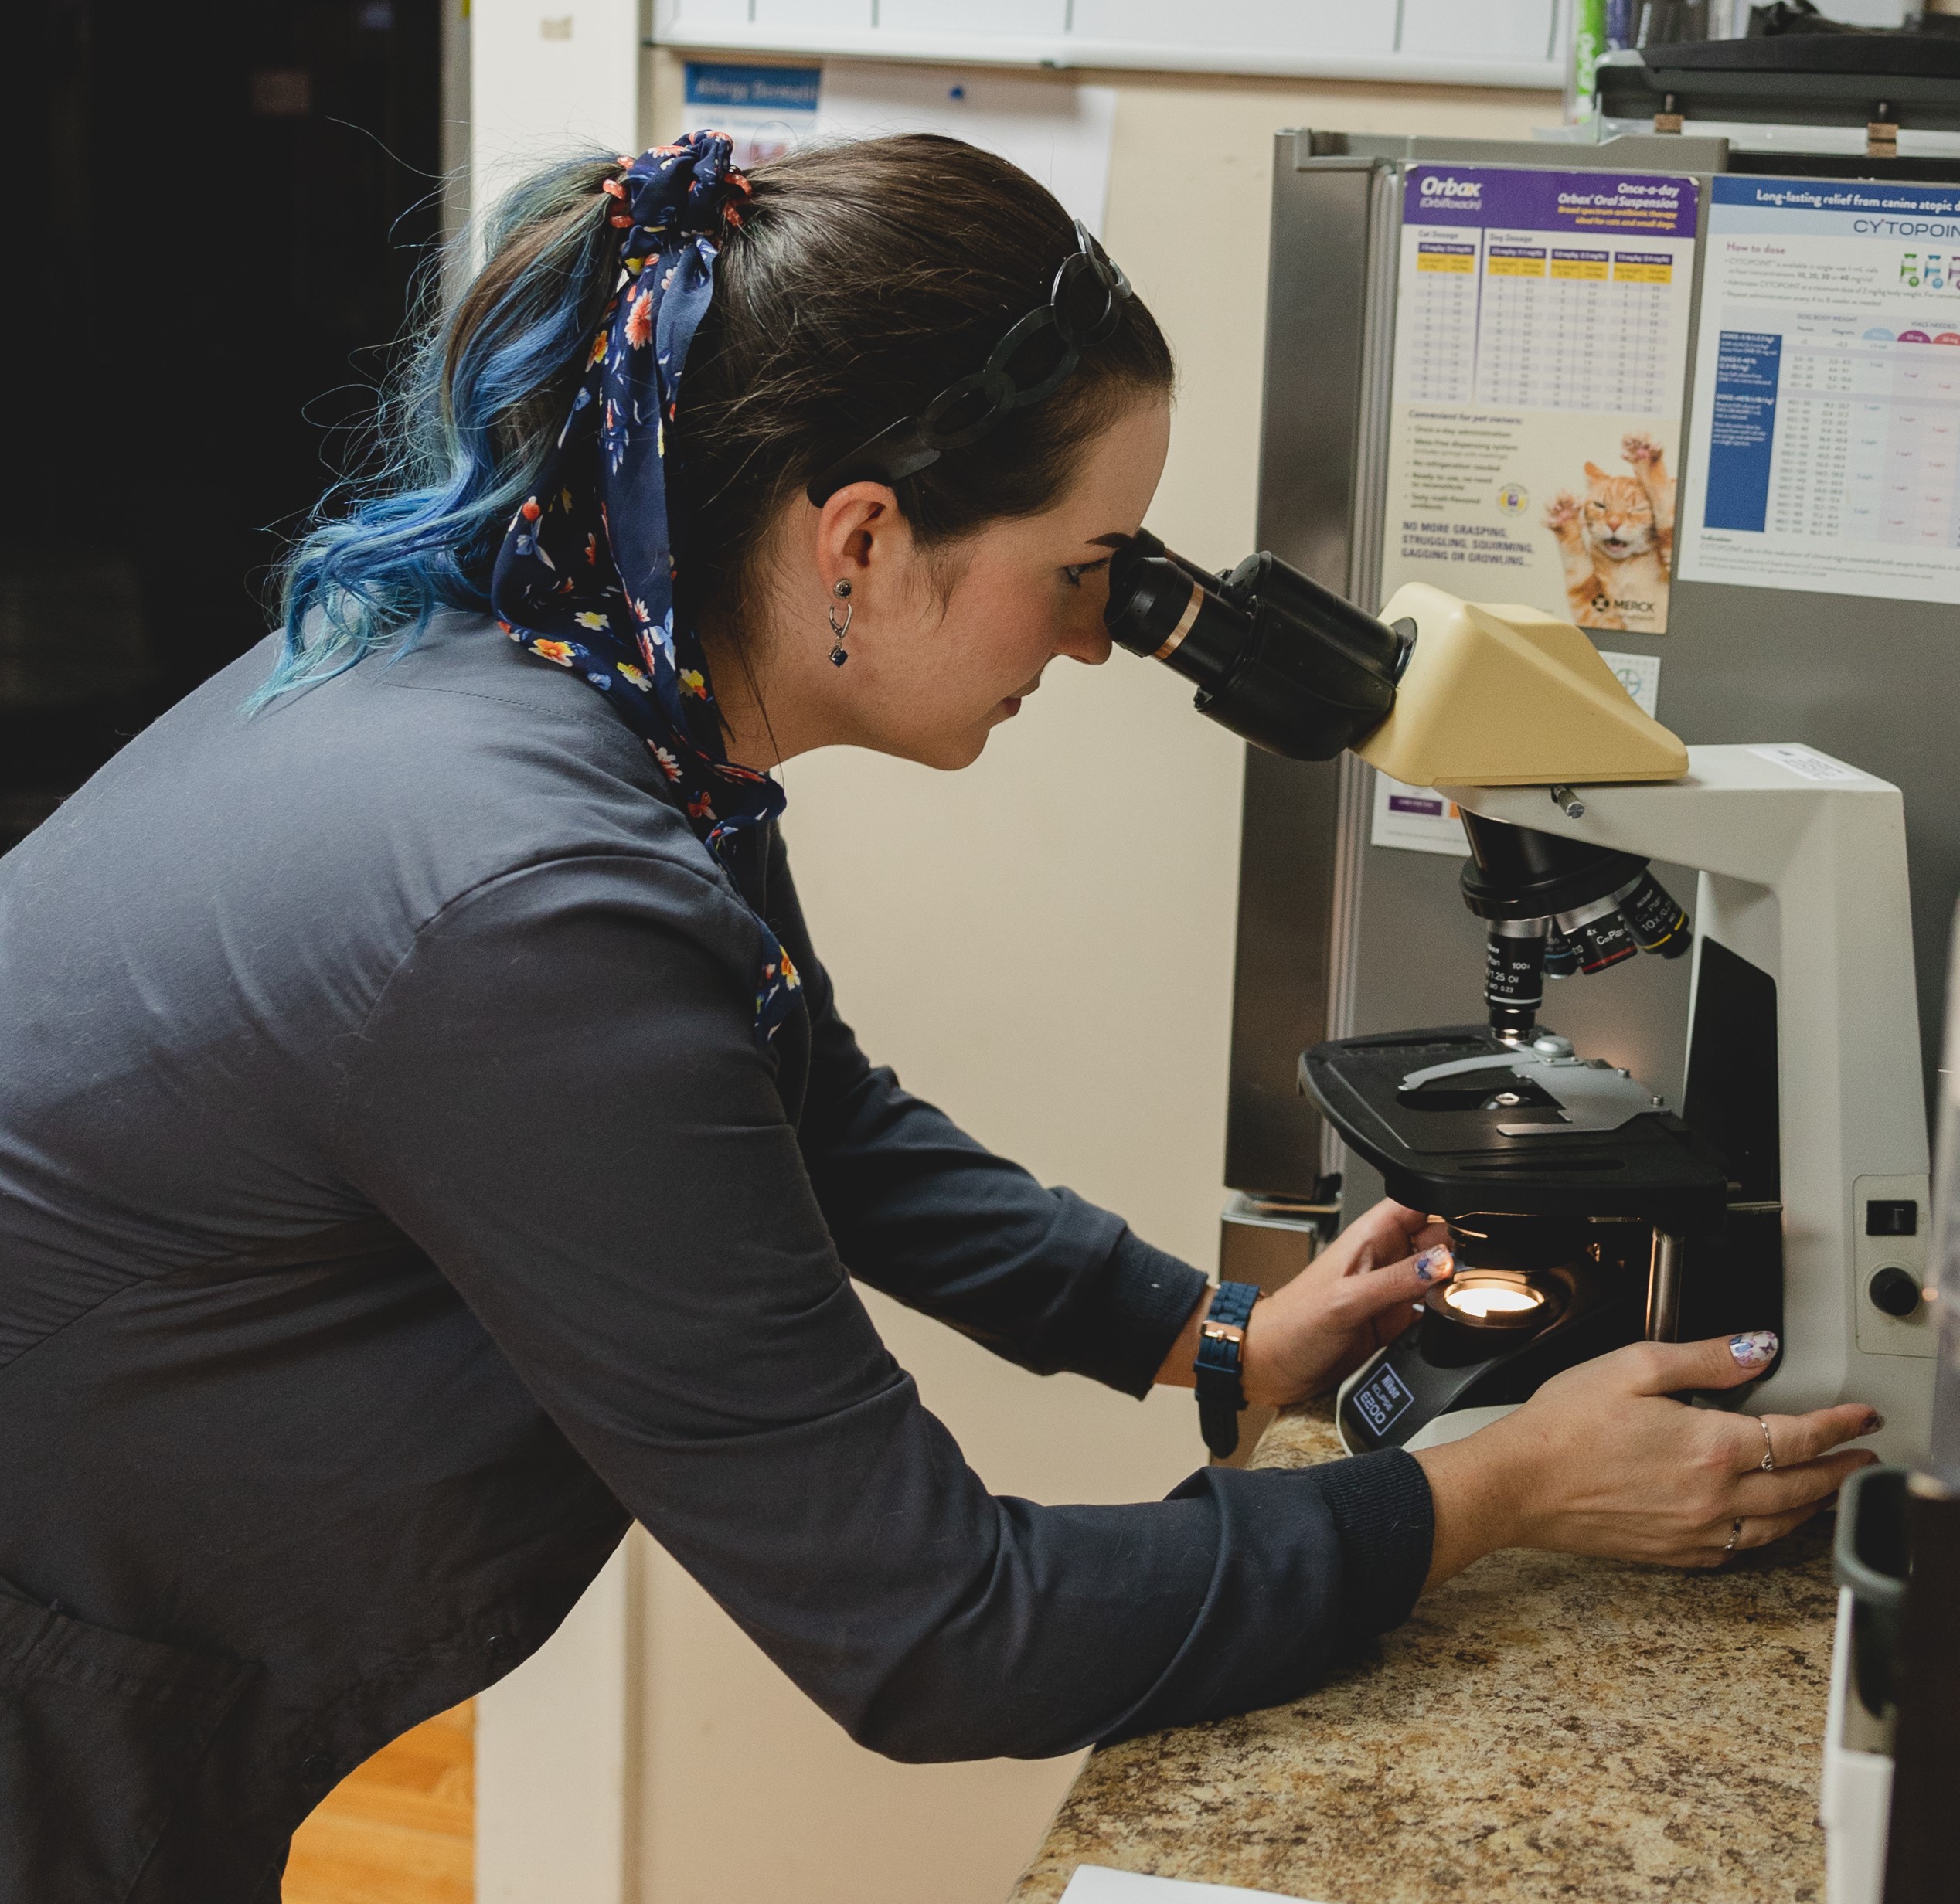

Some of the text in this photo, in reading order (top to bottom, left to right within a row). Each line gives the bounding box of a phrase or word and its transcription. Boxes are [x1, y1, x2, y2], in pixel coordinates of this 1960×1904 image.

[1421, 176, 1482, 197] Orbax
[1618, 182, 1680, 198] Once-a-day
[1594, 194, 1618, 206] Oral
[1618, 196, 1679, 209] Suspension
[1756, 189, 1822, 208] Long-lasting
[1823, 193, 1853, 206] relief
[1853, 194, 1880, 207] from
[1882, 197, 1917, 209] canine
[1918, 199, 1952, 214] atopic
[1726, 242, 1785, 254] How to dose
[1403, 521, 1417, 530] NO
[1421, 522, 1449, 533] MORE
[1401, 547, 1448, 560] GAGGING
[1451, 551, 1465, 561] OR
[1613, 600, 1655, 612] MERCK
[1586, 927, 1598, 937] 4x
[1381, 1374, 1400, 1399] Nikon
[1360, 1390, 1386, 1424] E200
